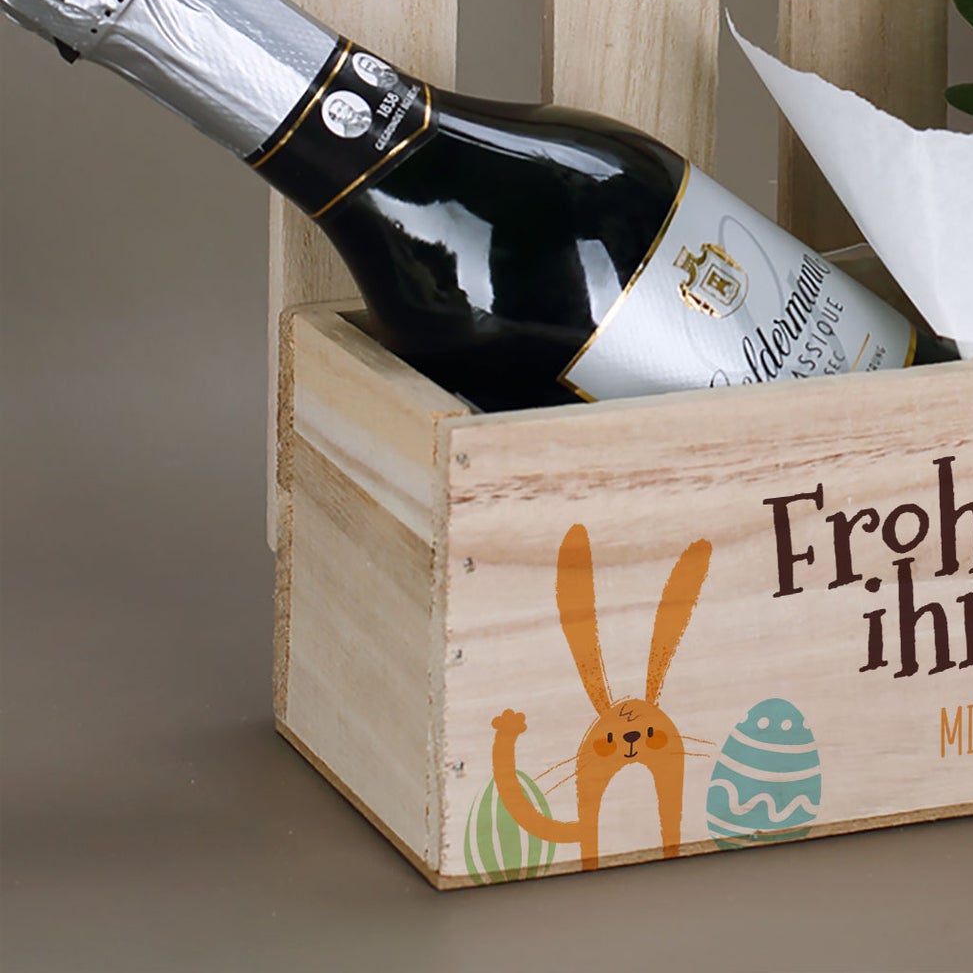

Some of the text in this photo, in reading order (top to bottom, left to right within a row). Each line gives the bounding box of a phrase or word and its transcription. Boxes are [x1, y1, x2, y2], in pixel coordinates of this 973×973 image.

[376, 91, 400, 119] 1838
[710, 253, 831, 388] ldermann
[791, 296, 844, 380] ASSIQUE
